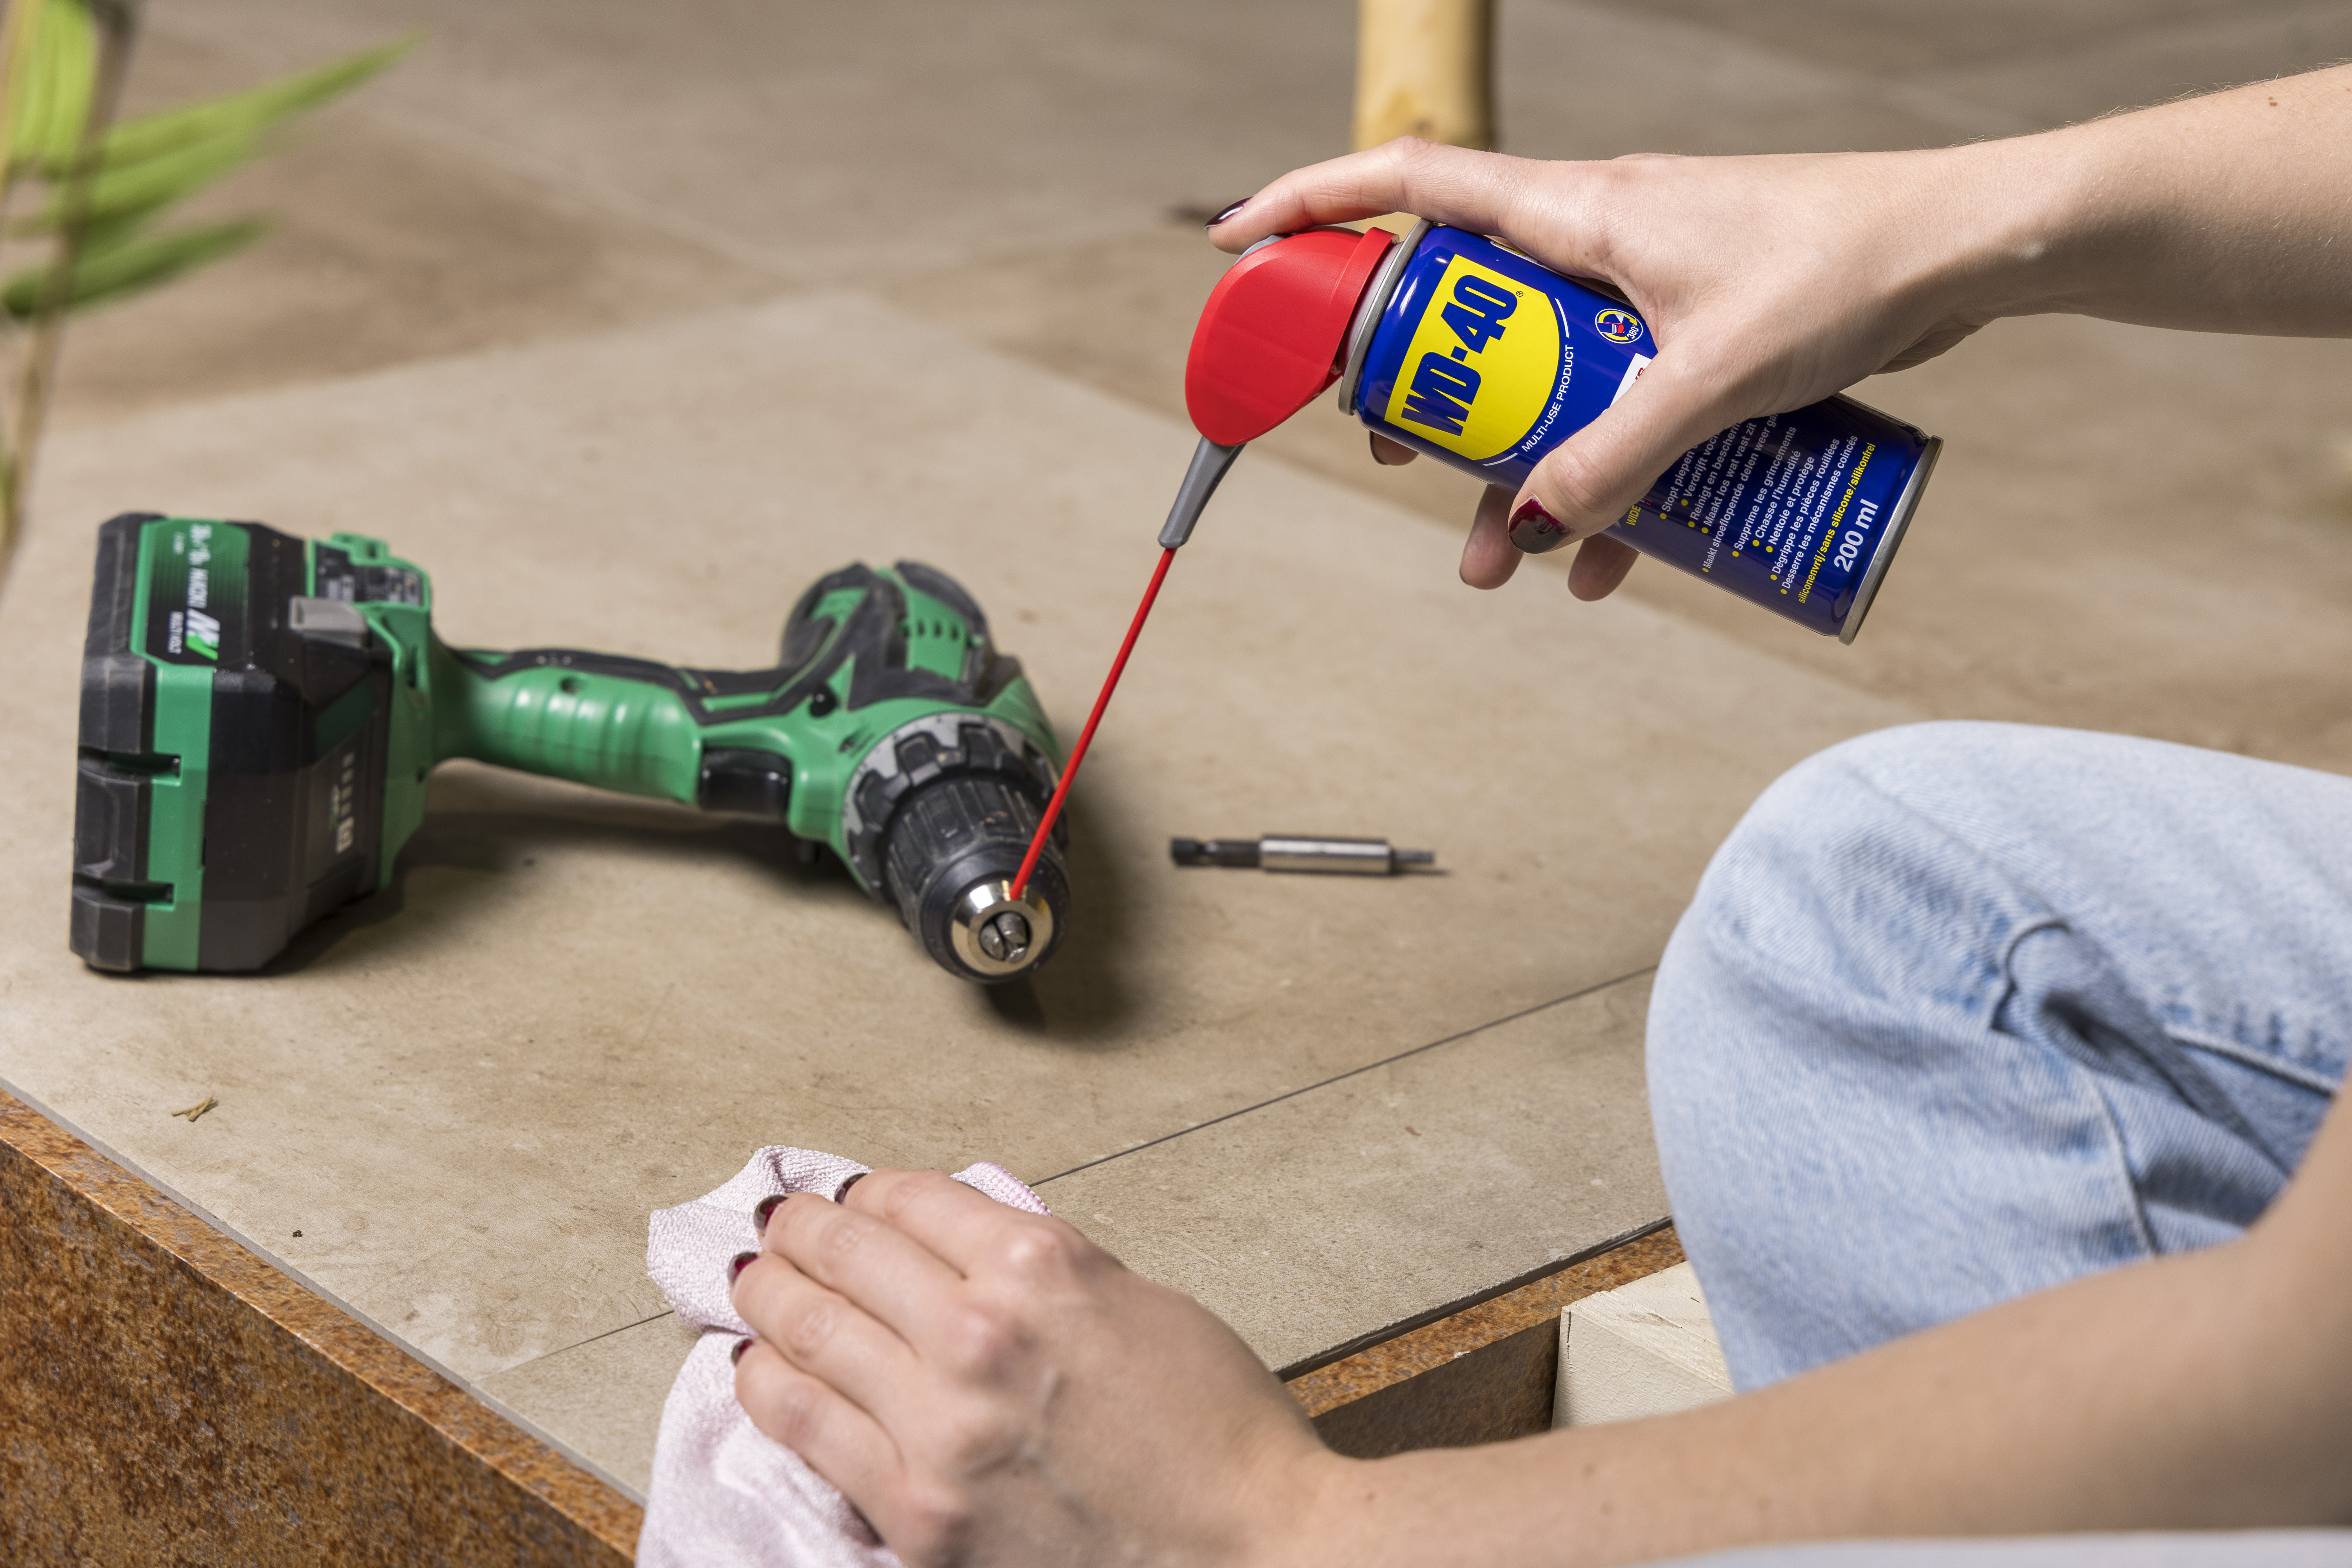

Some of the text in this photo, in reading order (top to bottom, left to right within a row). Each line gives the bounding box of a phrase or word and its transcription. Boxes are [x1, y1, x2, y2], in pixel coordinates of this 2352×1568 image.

[1627, 324, 1639, 339] 360°
[1521, 344, 1573, 452] MULTI-USE PRODUCT
[1626, 505, 1641, 525] WIDE
[1662, 450, 1694, 512] Stopt piepen
[1683, 457, 1707, 496] Verdrijft
[1690, 486, 1711, 520] Reinigt
[1707, 471, 1717, 484] en
[1702, 548, 1717, 568] Maakt
[1712, 483, 1744, 547] stroeflopende
[1740, 453, 1758, 481] delen
[1754, 427, 1769, 450] weer
[1703, 423, 1756, 526] Maakt los wat vast zit
[1734, 427, 1796, 550] Supprime les grincements
[1755, 450, 1800, 538] Chasse l’humidité
[1768, 457, 1814, 544] Nettoie et protège
[1772, 439, 1839, 573] Dégrippe les pièces rouillées
[1781, 436, 1857, 589] Desserre les mécanismes coincés
[1834, 499, 1878, 572] 200 ml
